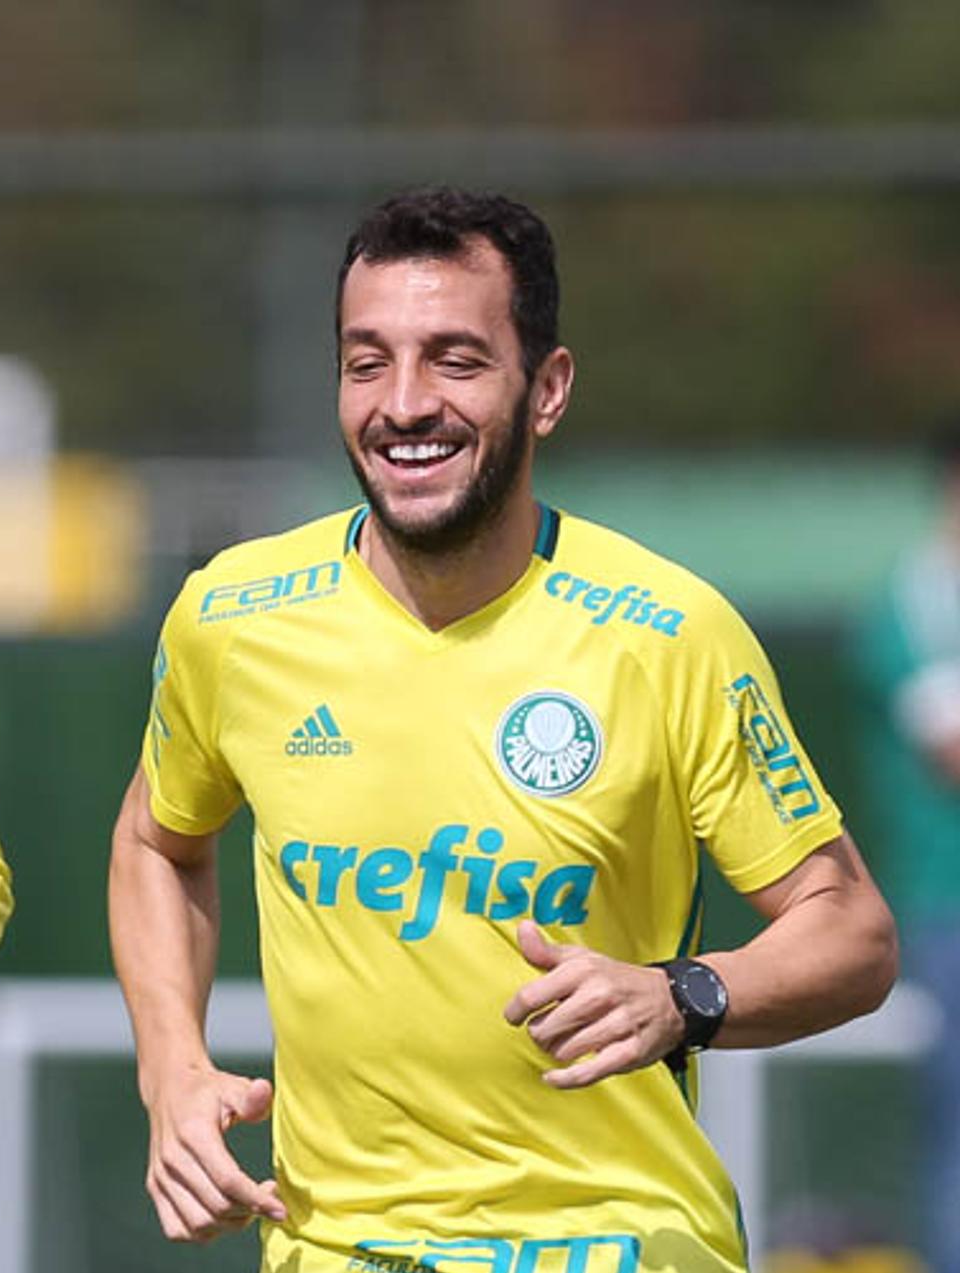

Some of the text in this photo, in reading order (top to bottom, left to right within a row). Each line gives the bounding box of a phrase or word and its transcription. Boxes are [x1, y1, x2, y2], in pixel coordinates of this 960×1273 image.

[544, 571, 686, 638] crefisa
[284, 736, 353, 757] adidas
[505, 736, 594, 788] PALMEIRAS
[279, 823, 598, 942] crefisa
